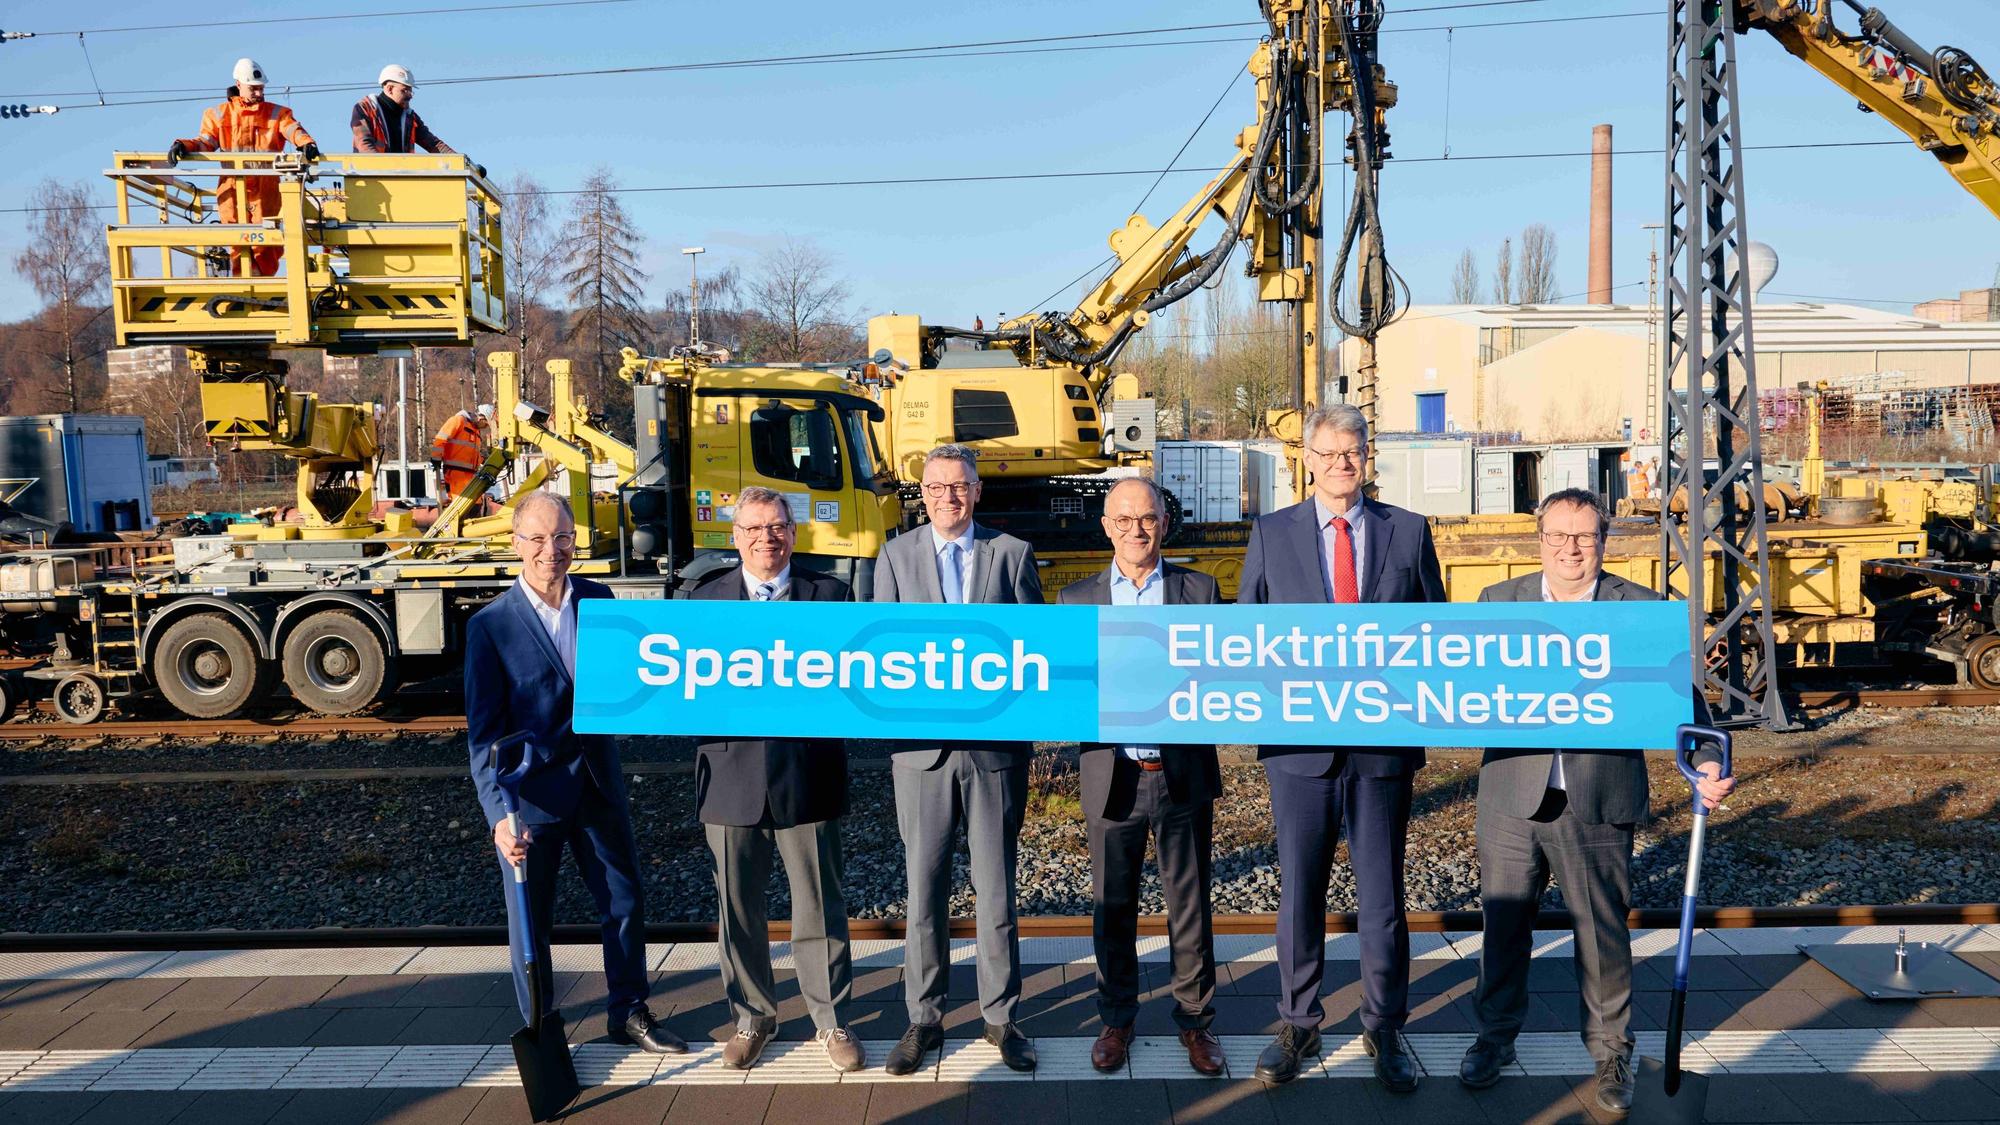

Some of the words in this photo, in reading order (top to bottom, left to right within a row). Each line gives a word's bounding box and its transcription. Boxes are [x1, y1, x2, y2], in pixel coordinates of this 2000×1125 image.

[240, 232, 265, 243] RPS
[903, 401, 929, 409] DELMAG
[637, 633, 1050, 700] Spatenstich
[1167, 622, 1612, 680] Elektrifizierung
[1168, 680, 1264, 723] des
[1281, 680, 1615, 726] EVS-Netzes
